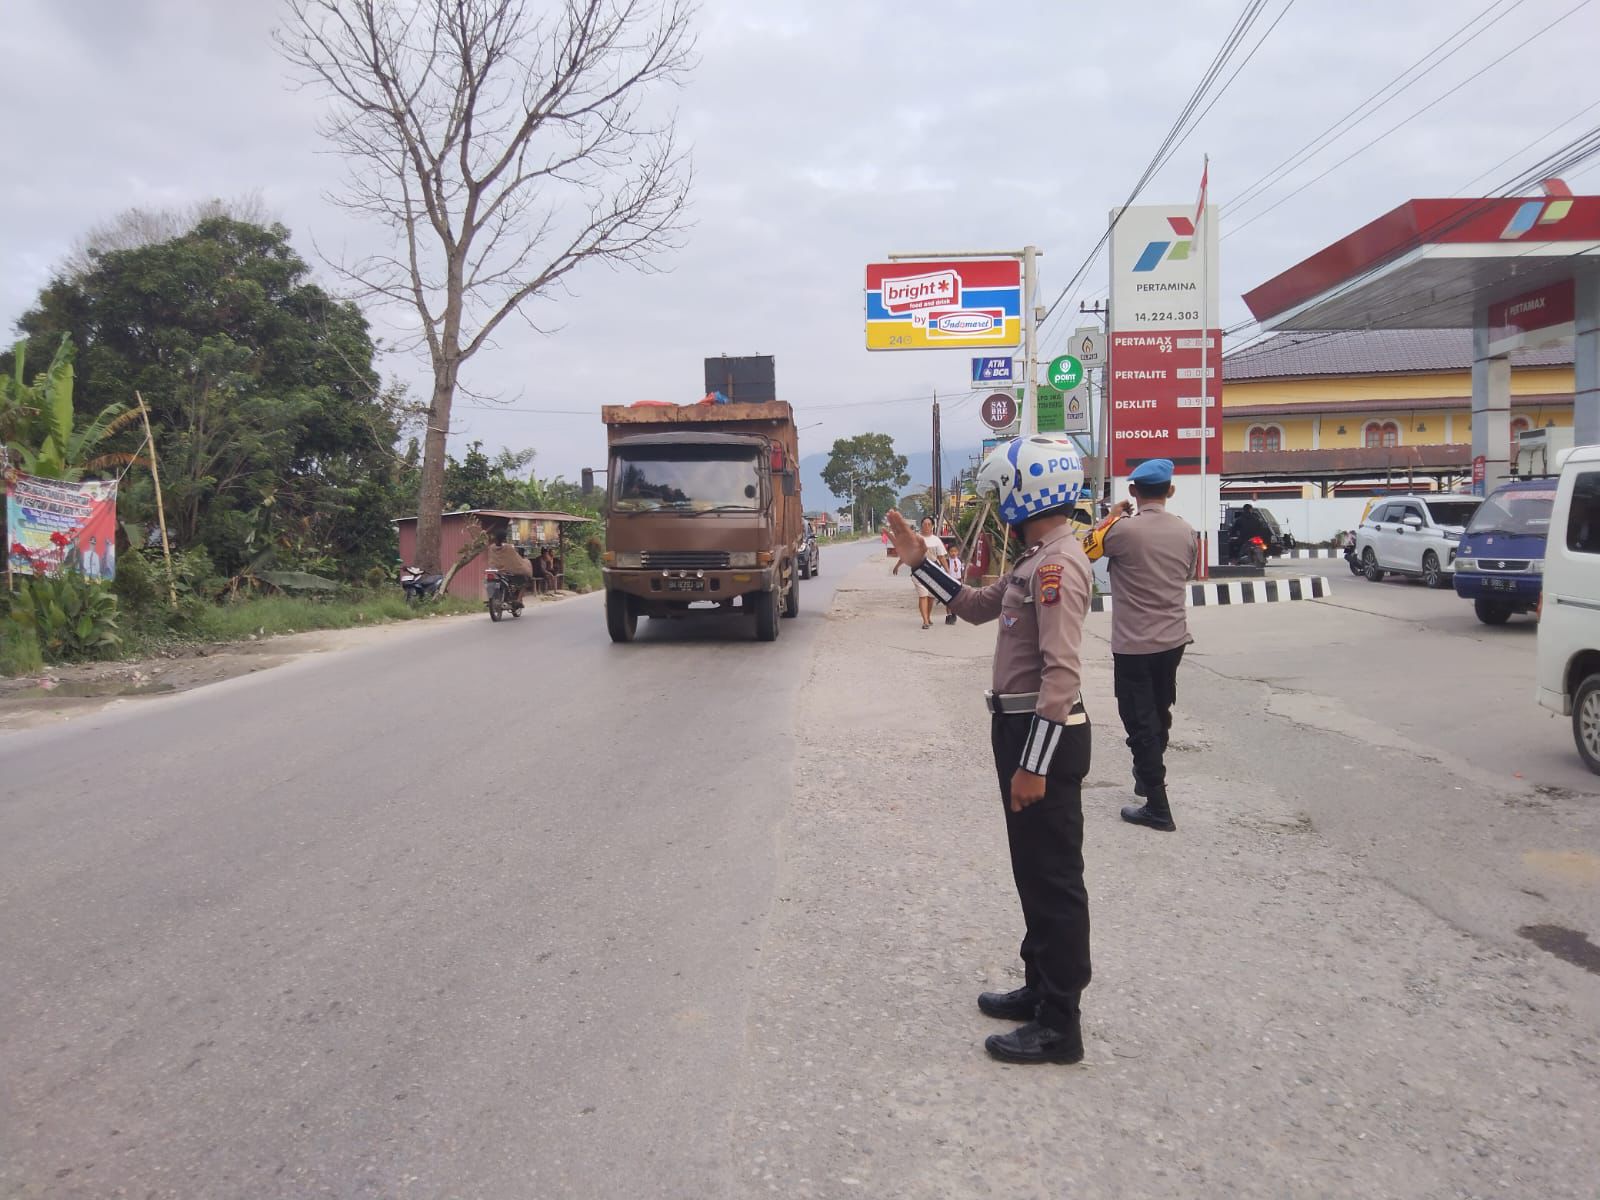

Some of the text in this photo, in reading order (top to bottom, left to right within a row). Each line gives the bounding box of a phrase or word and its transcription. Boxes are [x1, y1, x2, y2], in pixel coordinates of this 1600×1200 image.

[888, 282, 935, 299] bright
[1136, 283, 1196, 291] PERTAMINA
[914, 314, 927, 325] by
[1135, 311, 1199, 321] 14.224.303
[942, 318, 989, 329] Indomaret
[1115, 337, 1172, 346] PERTAMAX
[1160, 345, 1173, 353] 92
[988, 359, 1005, 368] ATM
[993, 368, 1009, 376] BCA
[1115, 370, 1167, 379] PERTALITE
[1115, 400, 1157, 408] DEXLITE
[1115, 430, 1169, 439] BIOSOLAR
